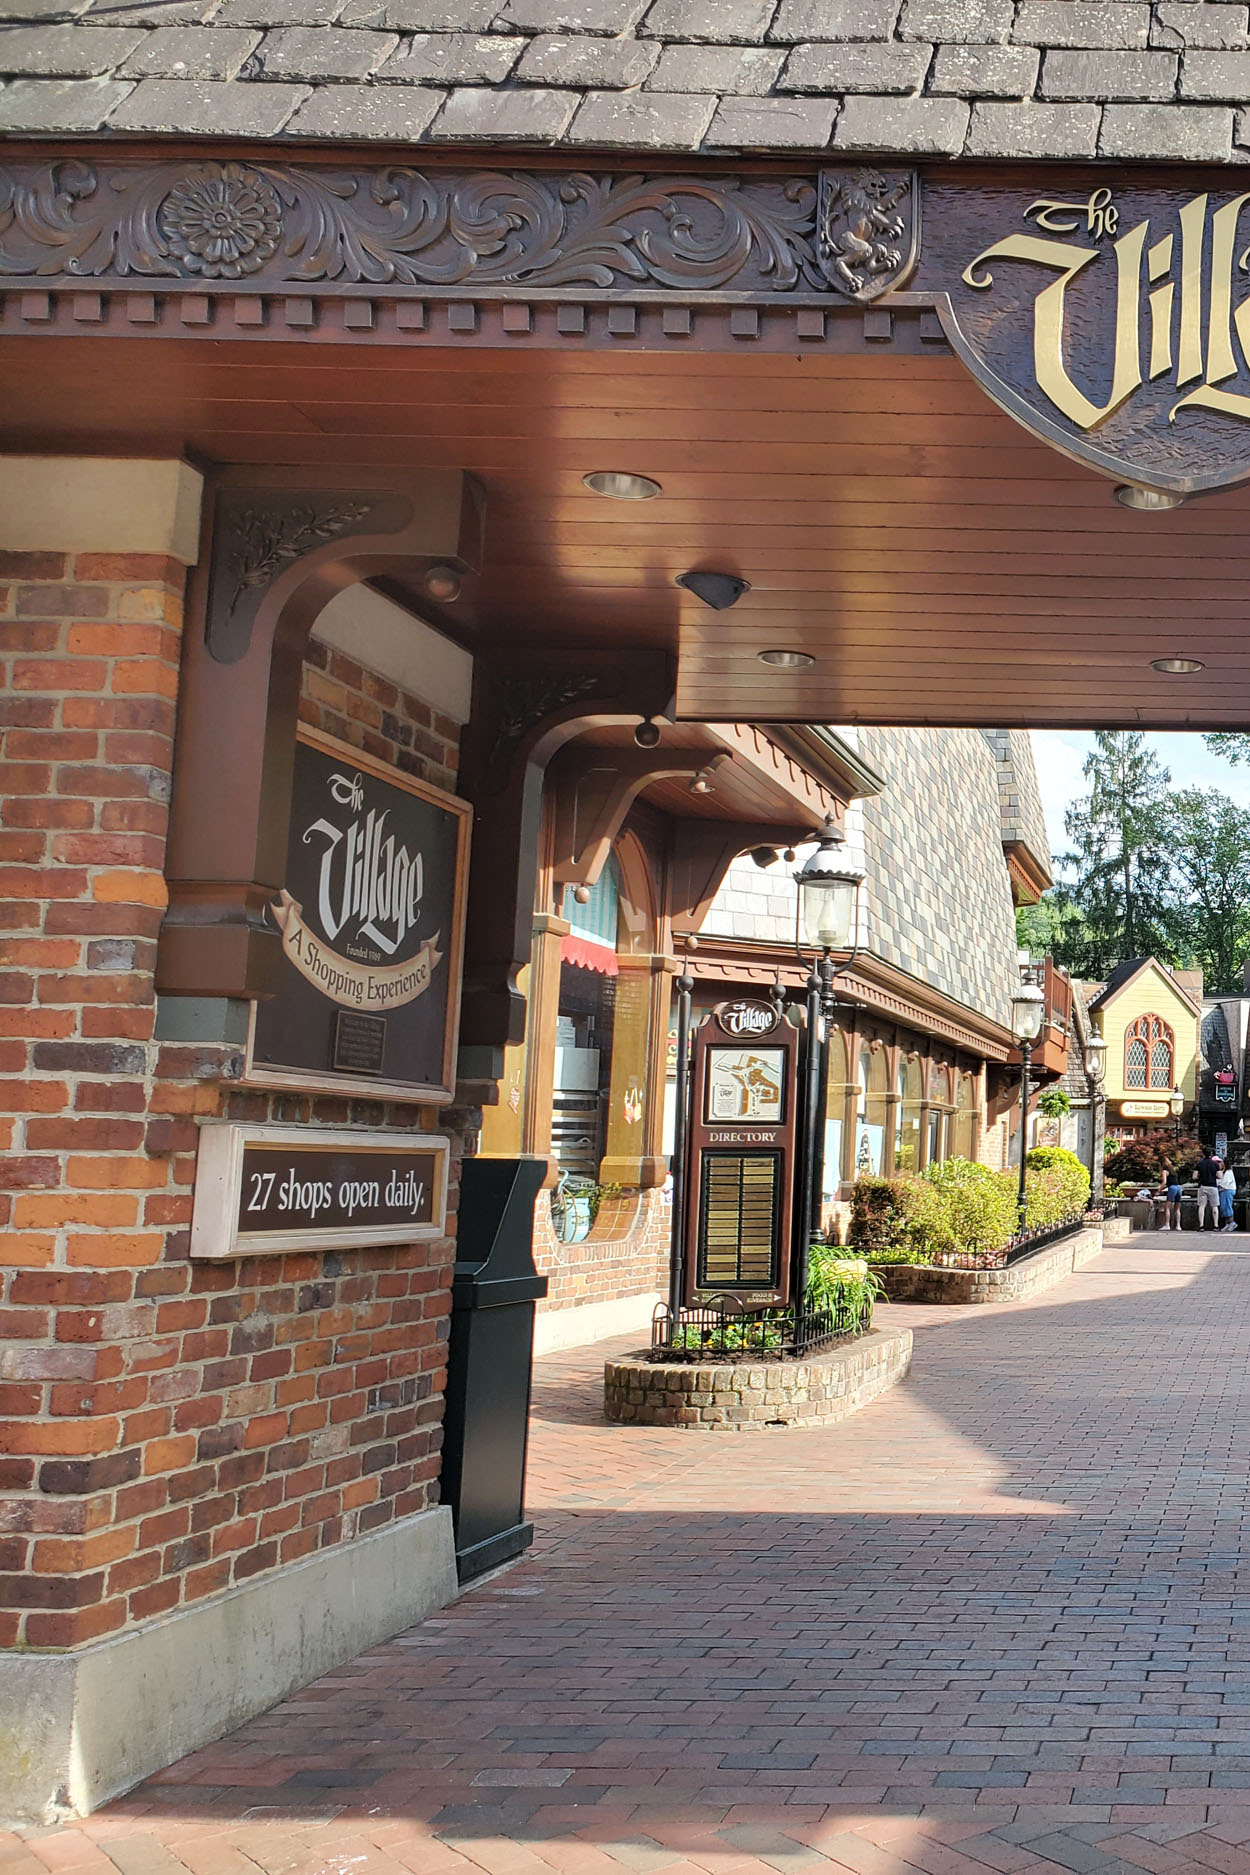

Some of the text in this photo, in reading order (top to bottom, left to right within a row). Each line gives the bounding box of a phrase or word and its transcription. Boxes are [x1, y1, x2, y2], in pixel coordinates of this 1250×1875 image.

[1023, 187, 1119, 239] The
[327, 772, 364, 812] The
[302, 808, 423, 955] Village
[288, 928, 427, 1005] A Shopping Experience
[346, 943, 368, 959] Founded
[724, 1007, 773, 1034] Village
[709, 1132, 777, 1142] DIRECTORY
[247, 1168, 425, 1219] 27 shops open daily.
